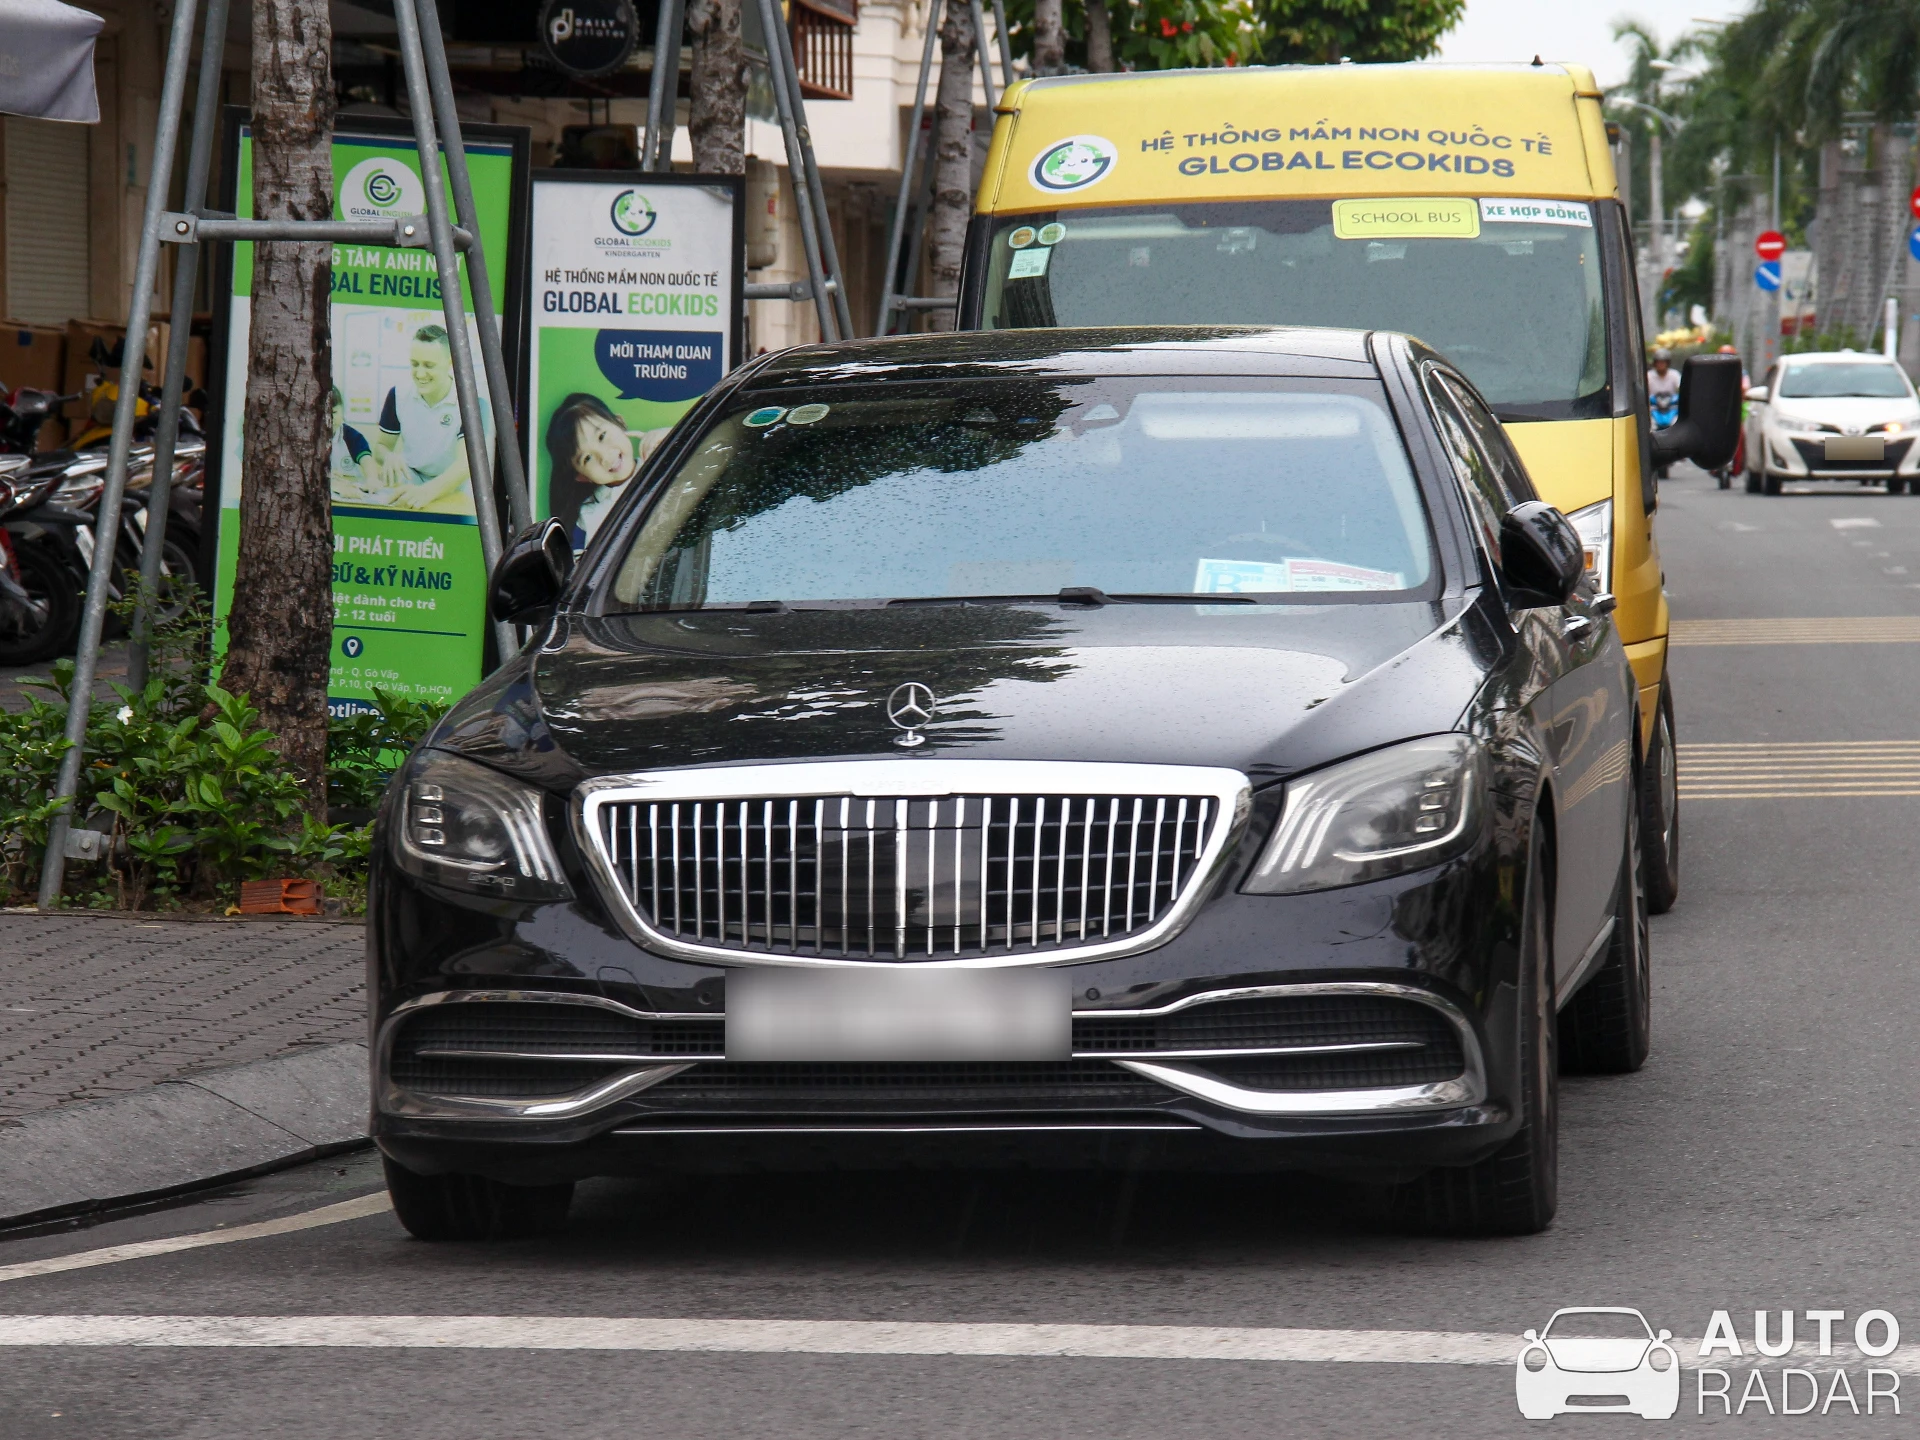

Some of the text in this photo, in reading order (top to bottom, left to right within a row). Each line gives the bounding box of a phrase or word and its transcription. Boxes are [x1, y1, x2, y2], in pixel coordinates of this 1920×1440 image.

[575, 17, 615, 29] DAILY
[1141, 130, 1175, 155] HỆ
[1359, 127, 1420, 142] NON
[1178, 150, 1516, 178] GLOBAL ECOKIDS
[350, 207, 413, 218] GLOBAL ENGLISH
[1351, 212, 1462, 223] SCHOOL BUS
[1485, 205, 1506, 216] XE
[1510, 205, 1541, 219] HỢP
[594, 237, 672, 248] GLOBAL ECOKIDS
[346, 247, 380, 269] TÂM
[384, 252, 421, 272] ANH
[604, 250, 661, 259] KINDERGARTEN
[544, 267, 561, 284] HỆ
[565, 267, 605, 284] THỐNG
[640, 272, 666, 286] NON
[668, 270, 701, 286] QUỐC
[704, 271, 719, 287] TẾ
[369, 274, 443, 300] ENGLIS
[543, 290, 719, 316] GLOBAL ECOKIDS
[609, 341, 712, 360] MỜI THAM QUAN
[633, 361, 688, 380] TRƯỜNG
[348, 534, 394, 556] PHÁT
[397, 536, 444, 560] TRIỂN
[331, 561, 452, 591] GỮ & KỸ NĂNG
[332, 591, 437, 611] iệt dành cho trẻ
[351, 609, 367, 621] 12
[368, 610, 397, 623] tuổi
[351, 667, 362, 678] Q.
[365, 668, 378, 679] Gò
[374, 681, 390, 691] Gò
[414, 684, 453, 696] Tp.HCM
